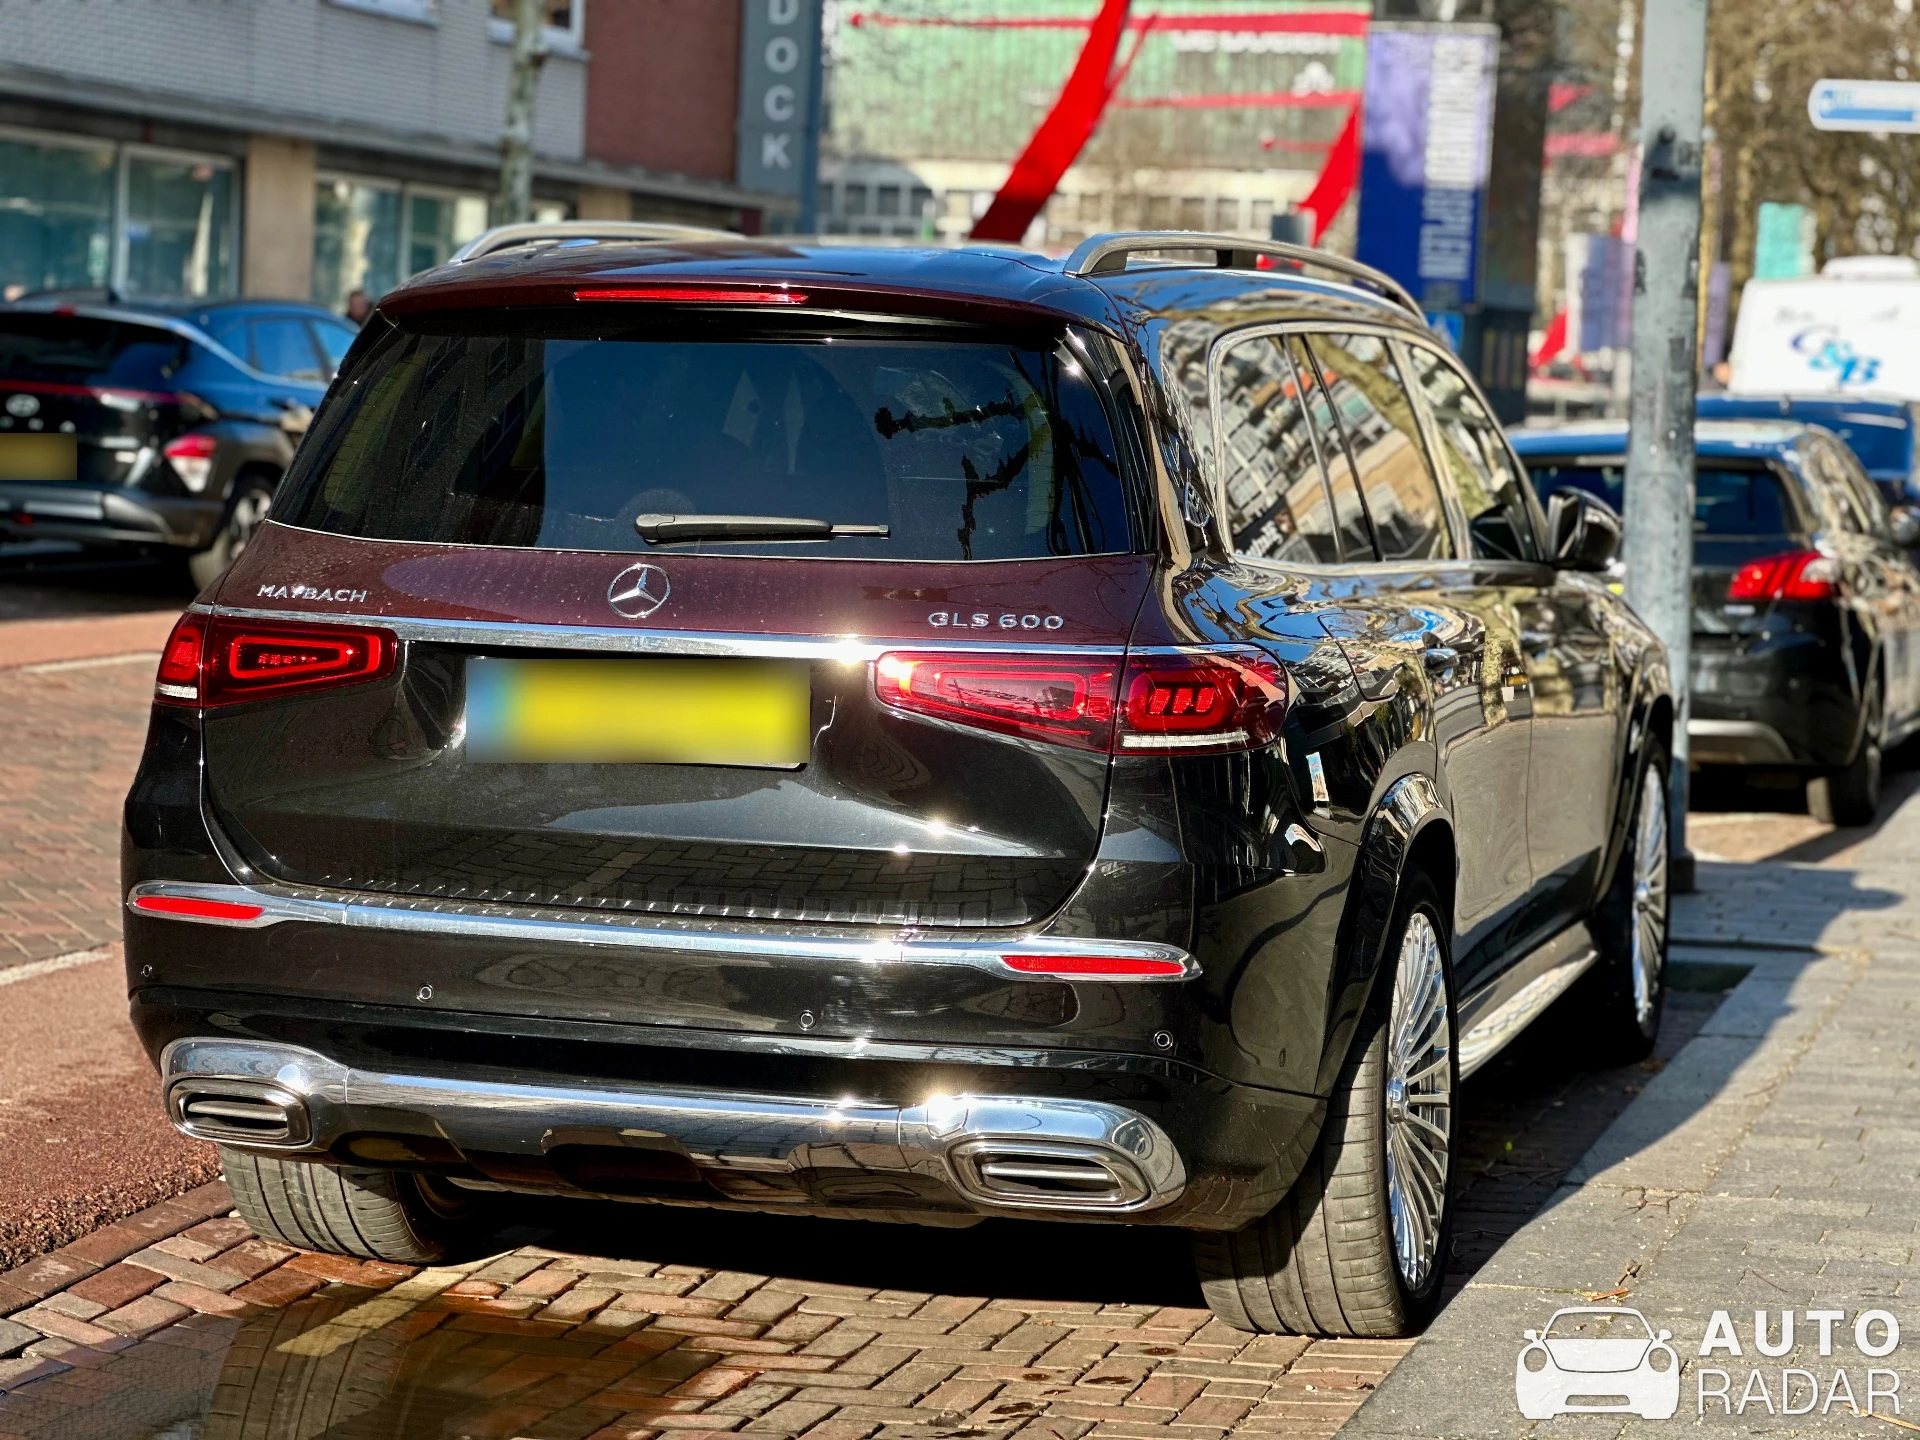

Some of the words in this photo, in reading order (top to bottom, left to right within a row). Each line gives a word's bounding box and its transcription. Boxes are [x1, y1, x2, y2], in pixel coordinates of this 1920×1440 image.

[762, 0, 799, 169] DOCK
[257, 584, 367, 602] MAYBACH
[928, 611, 990, 629] GLS
[999, 613, 1064, 630] 600
